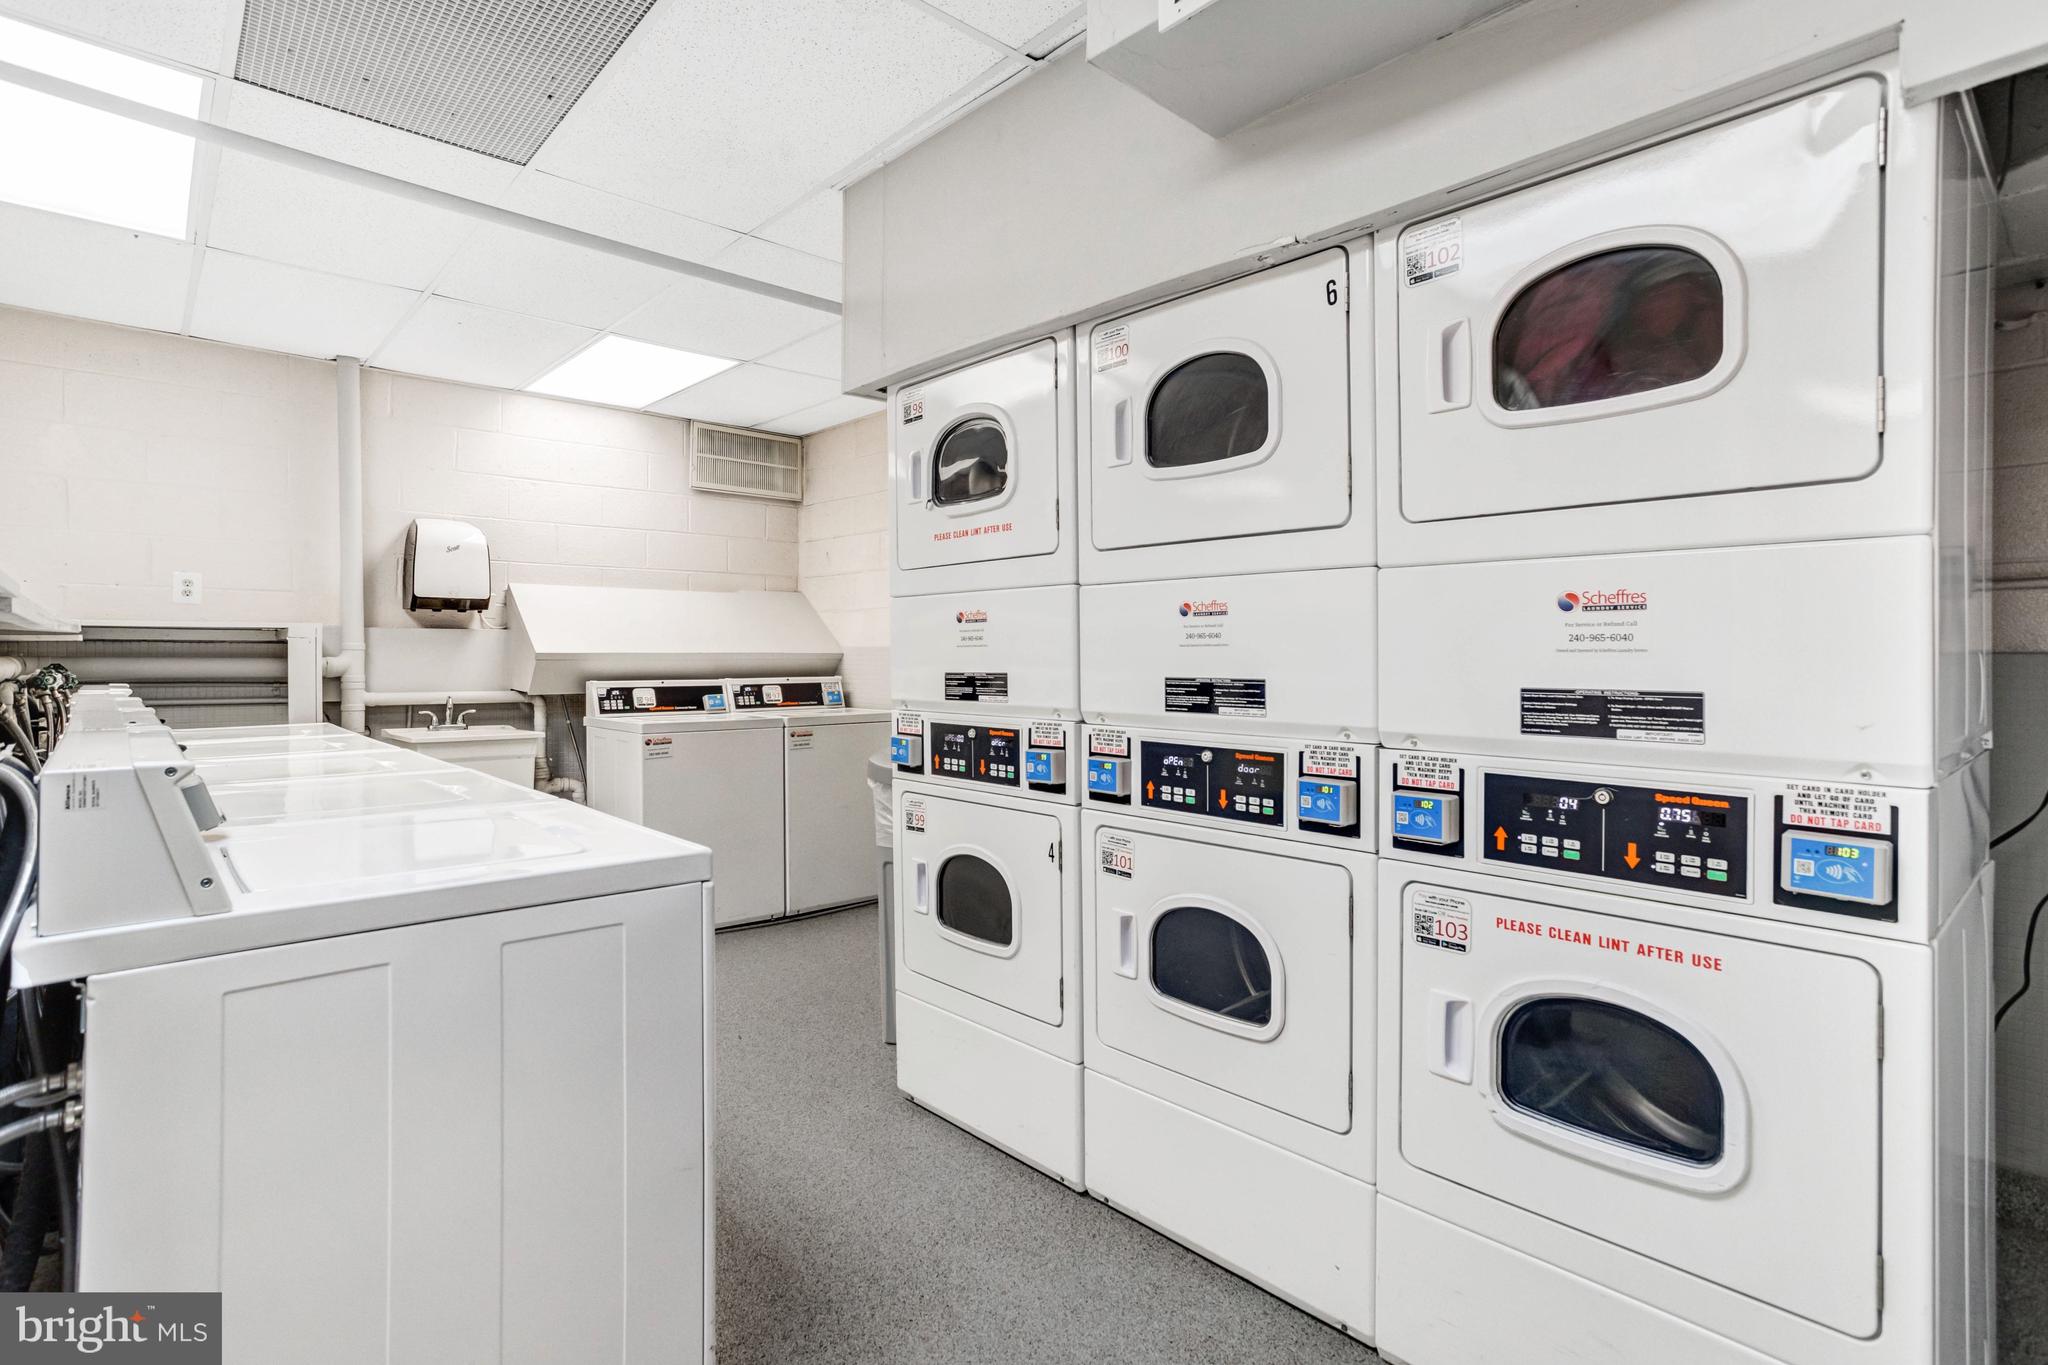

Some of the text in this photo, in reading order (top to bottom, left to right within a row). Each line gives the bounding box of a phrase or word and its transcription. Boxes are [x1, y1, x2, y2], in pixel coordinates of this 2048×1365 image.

[1428, 243, 1460, 268] 102
[1326, 280, 1337, 305] 6
[913, 401, 923, 415] 98
[934, 523, 1012, 541] PLEASE CLEAN LINT AFTER USE
[1582, 588, 1647, 605] Scheffres
[1193, 600, 1228, 612] Scheffres
[1568, 633, 1634, 642] 240-965-6040
[1235, 752, 1275, 762] Speed Queen
[1338, 768, 1352, 776] CARD
[1411, 778, 1423, 786] NOT
[1439, 781, 1455, 789] CARD
[1835, 787, 1854, 795] CARD
[1421, 800, 1434, 809] 102
[1559, 797, 1578, 810] 04
[1654, 792, 1731, 809] Speed Queen
[1794, 799, 1814, 807] UNTIL
[1817, 801, 1849, 810] MACHINE
[914, 813, 925, 827] 99
[1820, 809, 1849, 817] REMOVE
[1853, 812, 1872, 820] CARD
[1790, 814, 1882, 832] DO NOT TAP CARD
[1048, 842, 1055, 863] 4
[1838, 847, 1860, 859] 103
[1114, 854, 1133, 871] 101
[1435, 919, 1468, 941] 103
[1496, 917, 1723, 972] PLEASE CLEAN LINT AFTER USE
